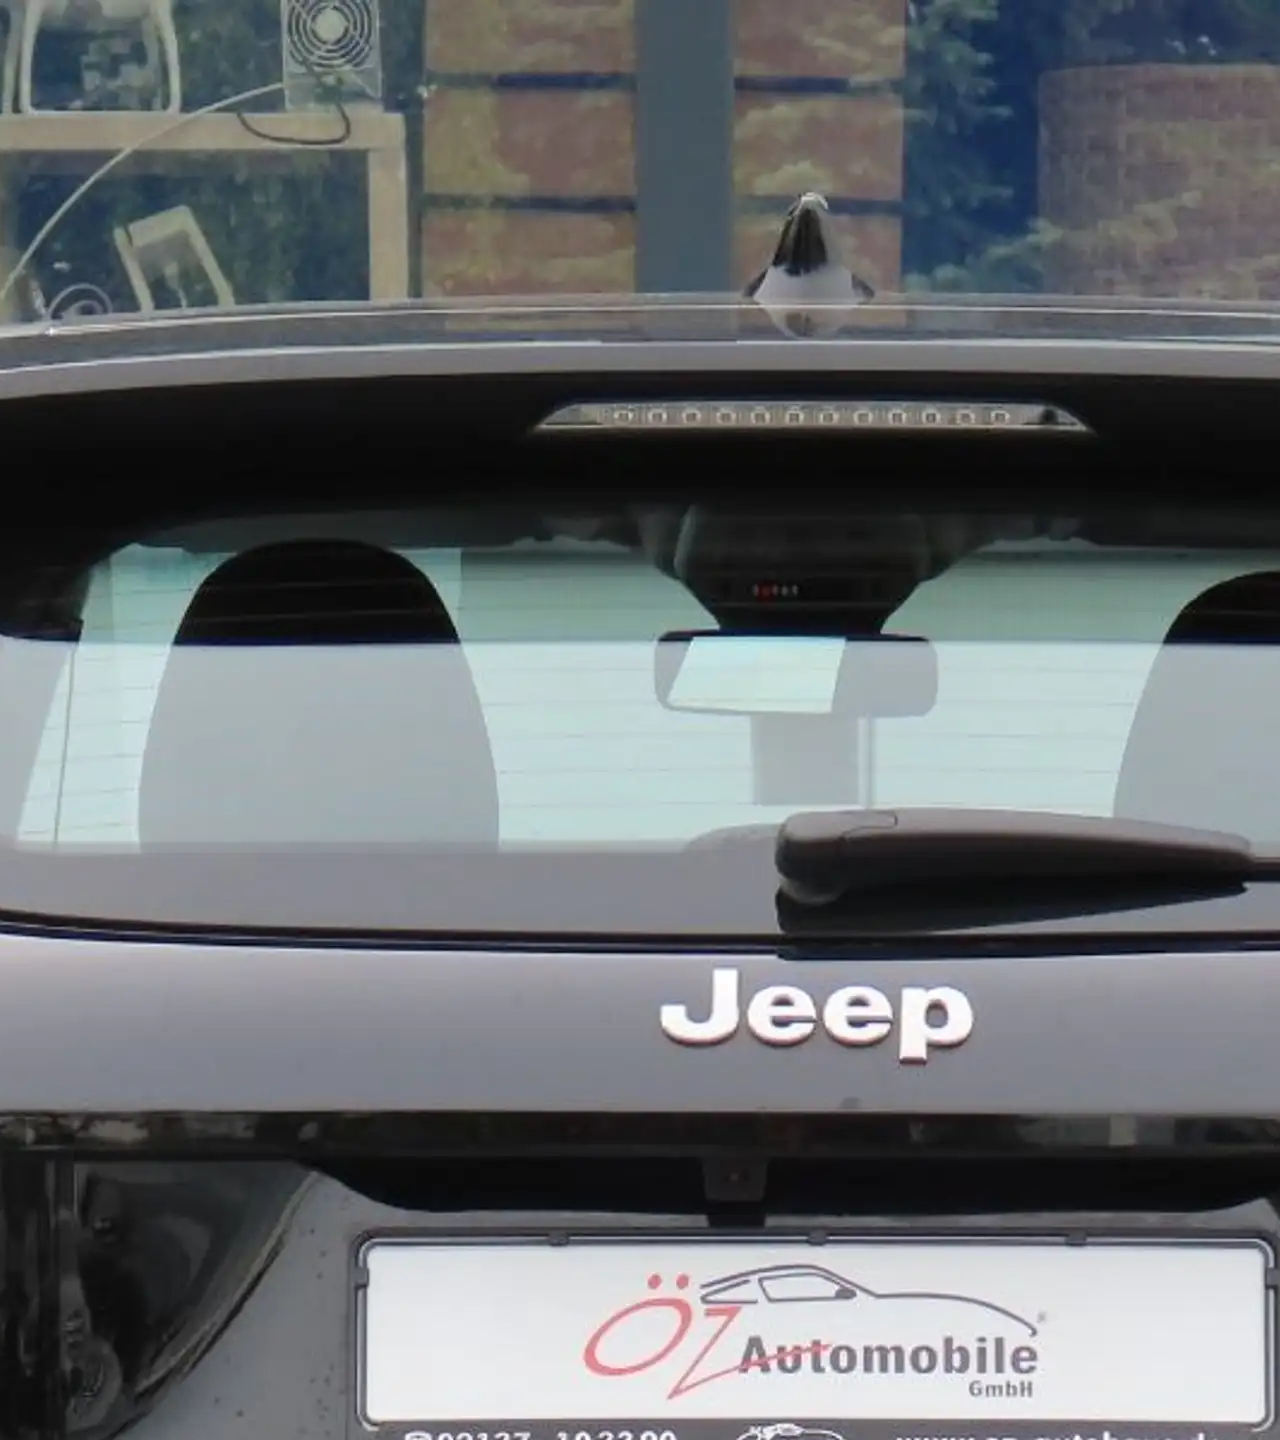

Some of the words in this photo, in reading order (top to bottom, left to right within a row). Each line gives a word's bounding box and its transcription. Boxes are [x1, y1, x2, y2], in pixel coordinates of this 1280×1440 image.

[660, 967, 974, 1064] Jeep
[738, 1336, 1038, 1375] Automobile
[968, 1379, 1033, 1398] GmbH
